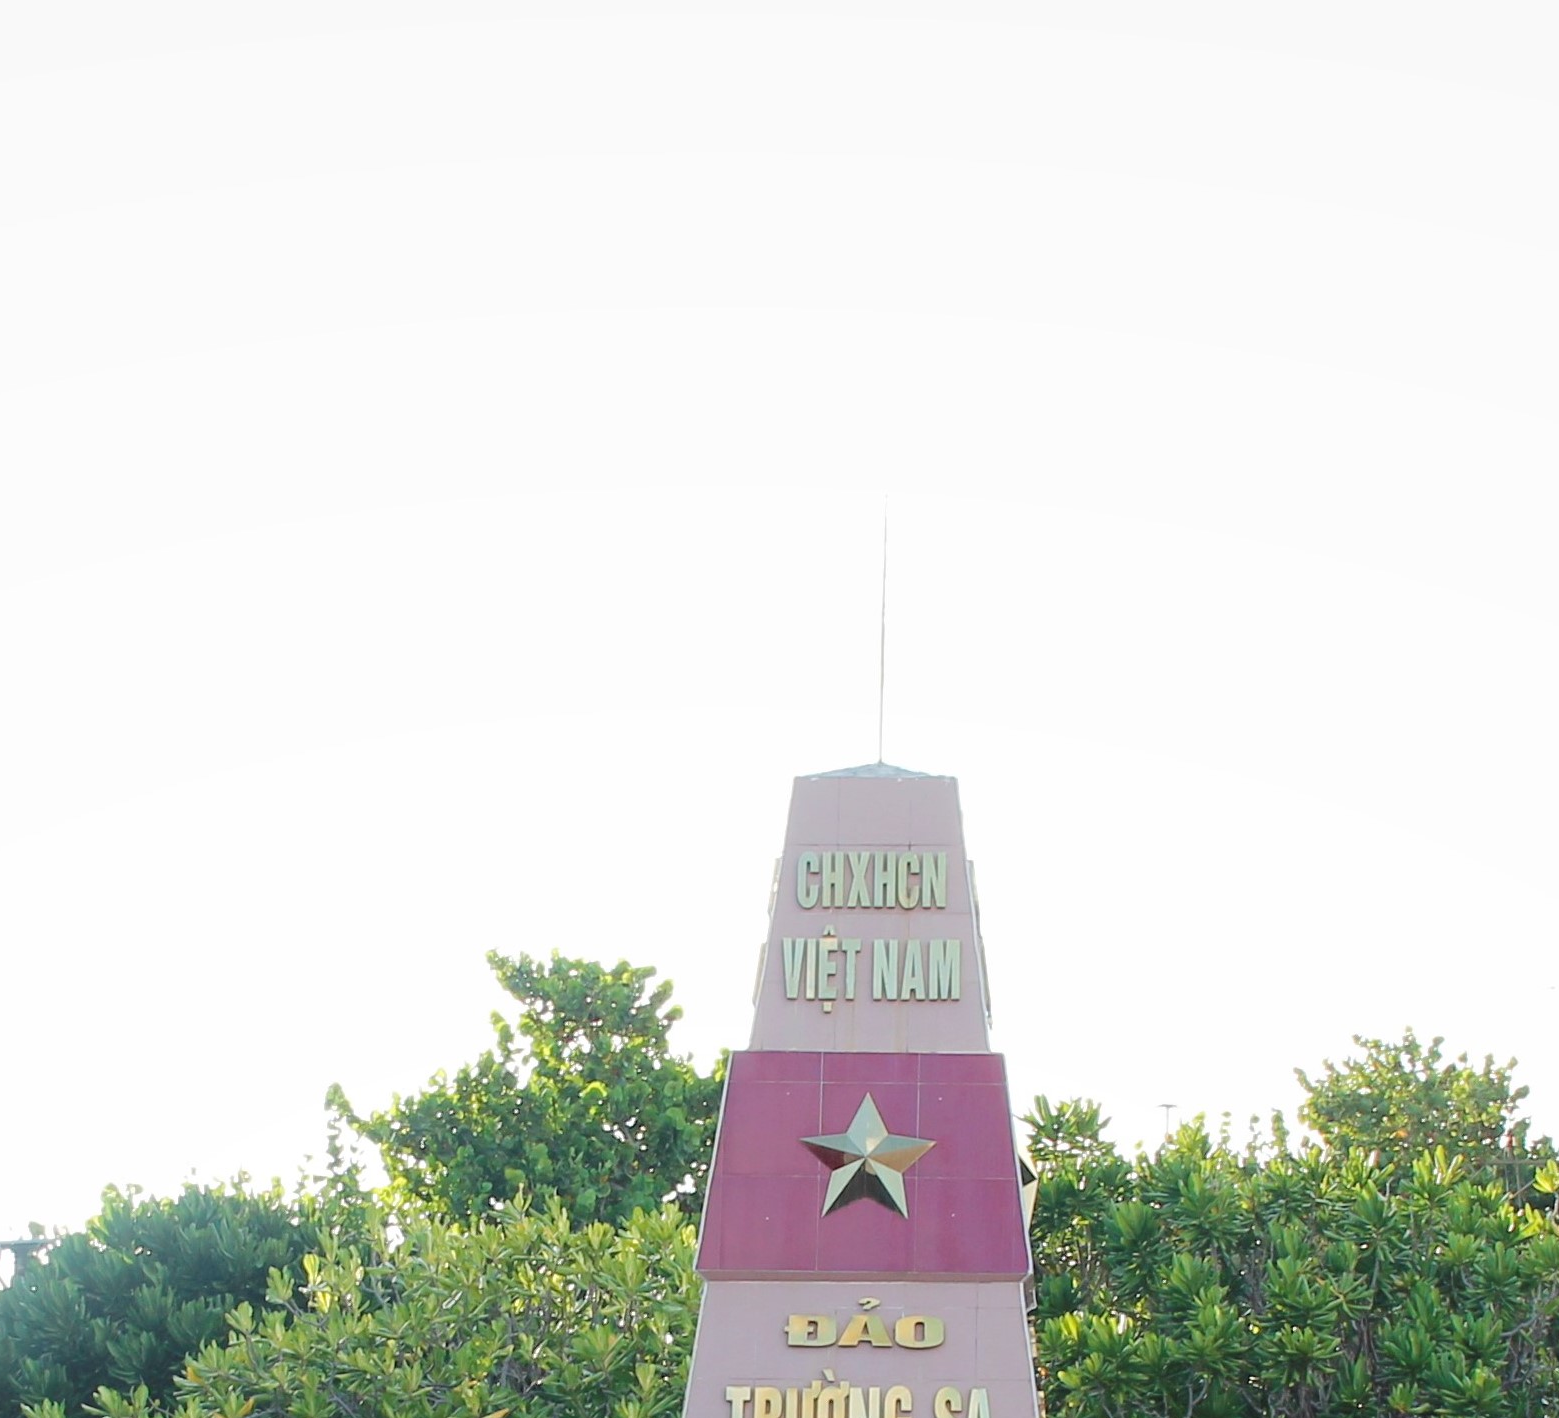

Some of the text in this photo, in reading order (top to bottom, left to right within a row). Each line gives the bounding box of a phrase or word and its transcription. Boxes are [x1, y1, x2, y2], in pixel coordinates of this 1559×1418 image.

[796, 851, 947, 910] CHXHCN
[781, 924, 962, 1013] VIỆT NAM
[784, 1296, 945, 1350] ĐẢO
